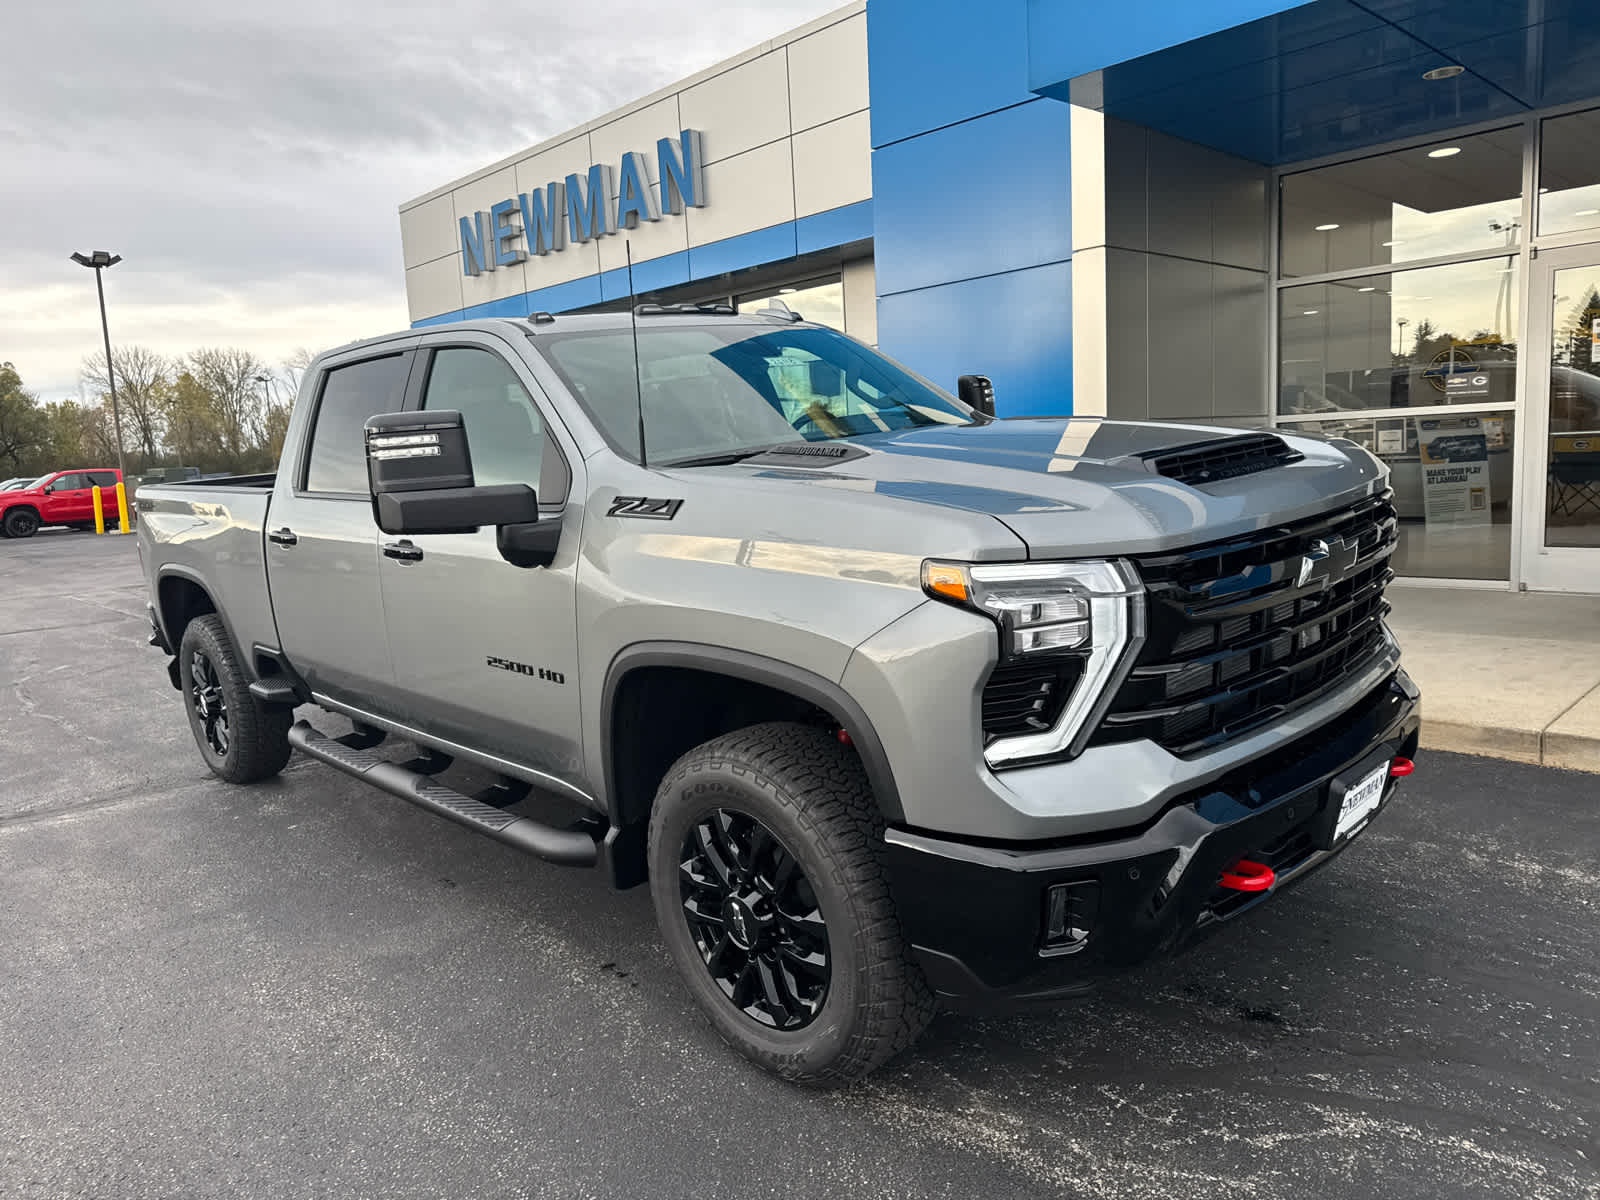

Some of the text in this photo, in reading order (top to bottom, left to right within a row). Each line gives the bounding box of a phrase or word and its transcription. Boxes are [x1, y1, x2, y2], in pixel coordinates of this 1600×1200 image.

[459, 128, 704, 276] NEWMAN
[1426, 468, 1446, 477] MAKE
[606, 496, 684, 520] Z71
[486, 655, 565, 684] 2500 HD
